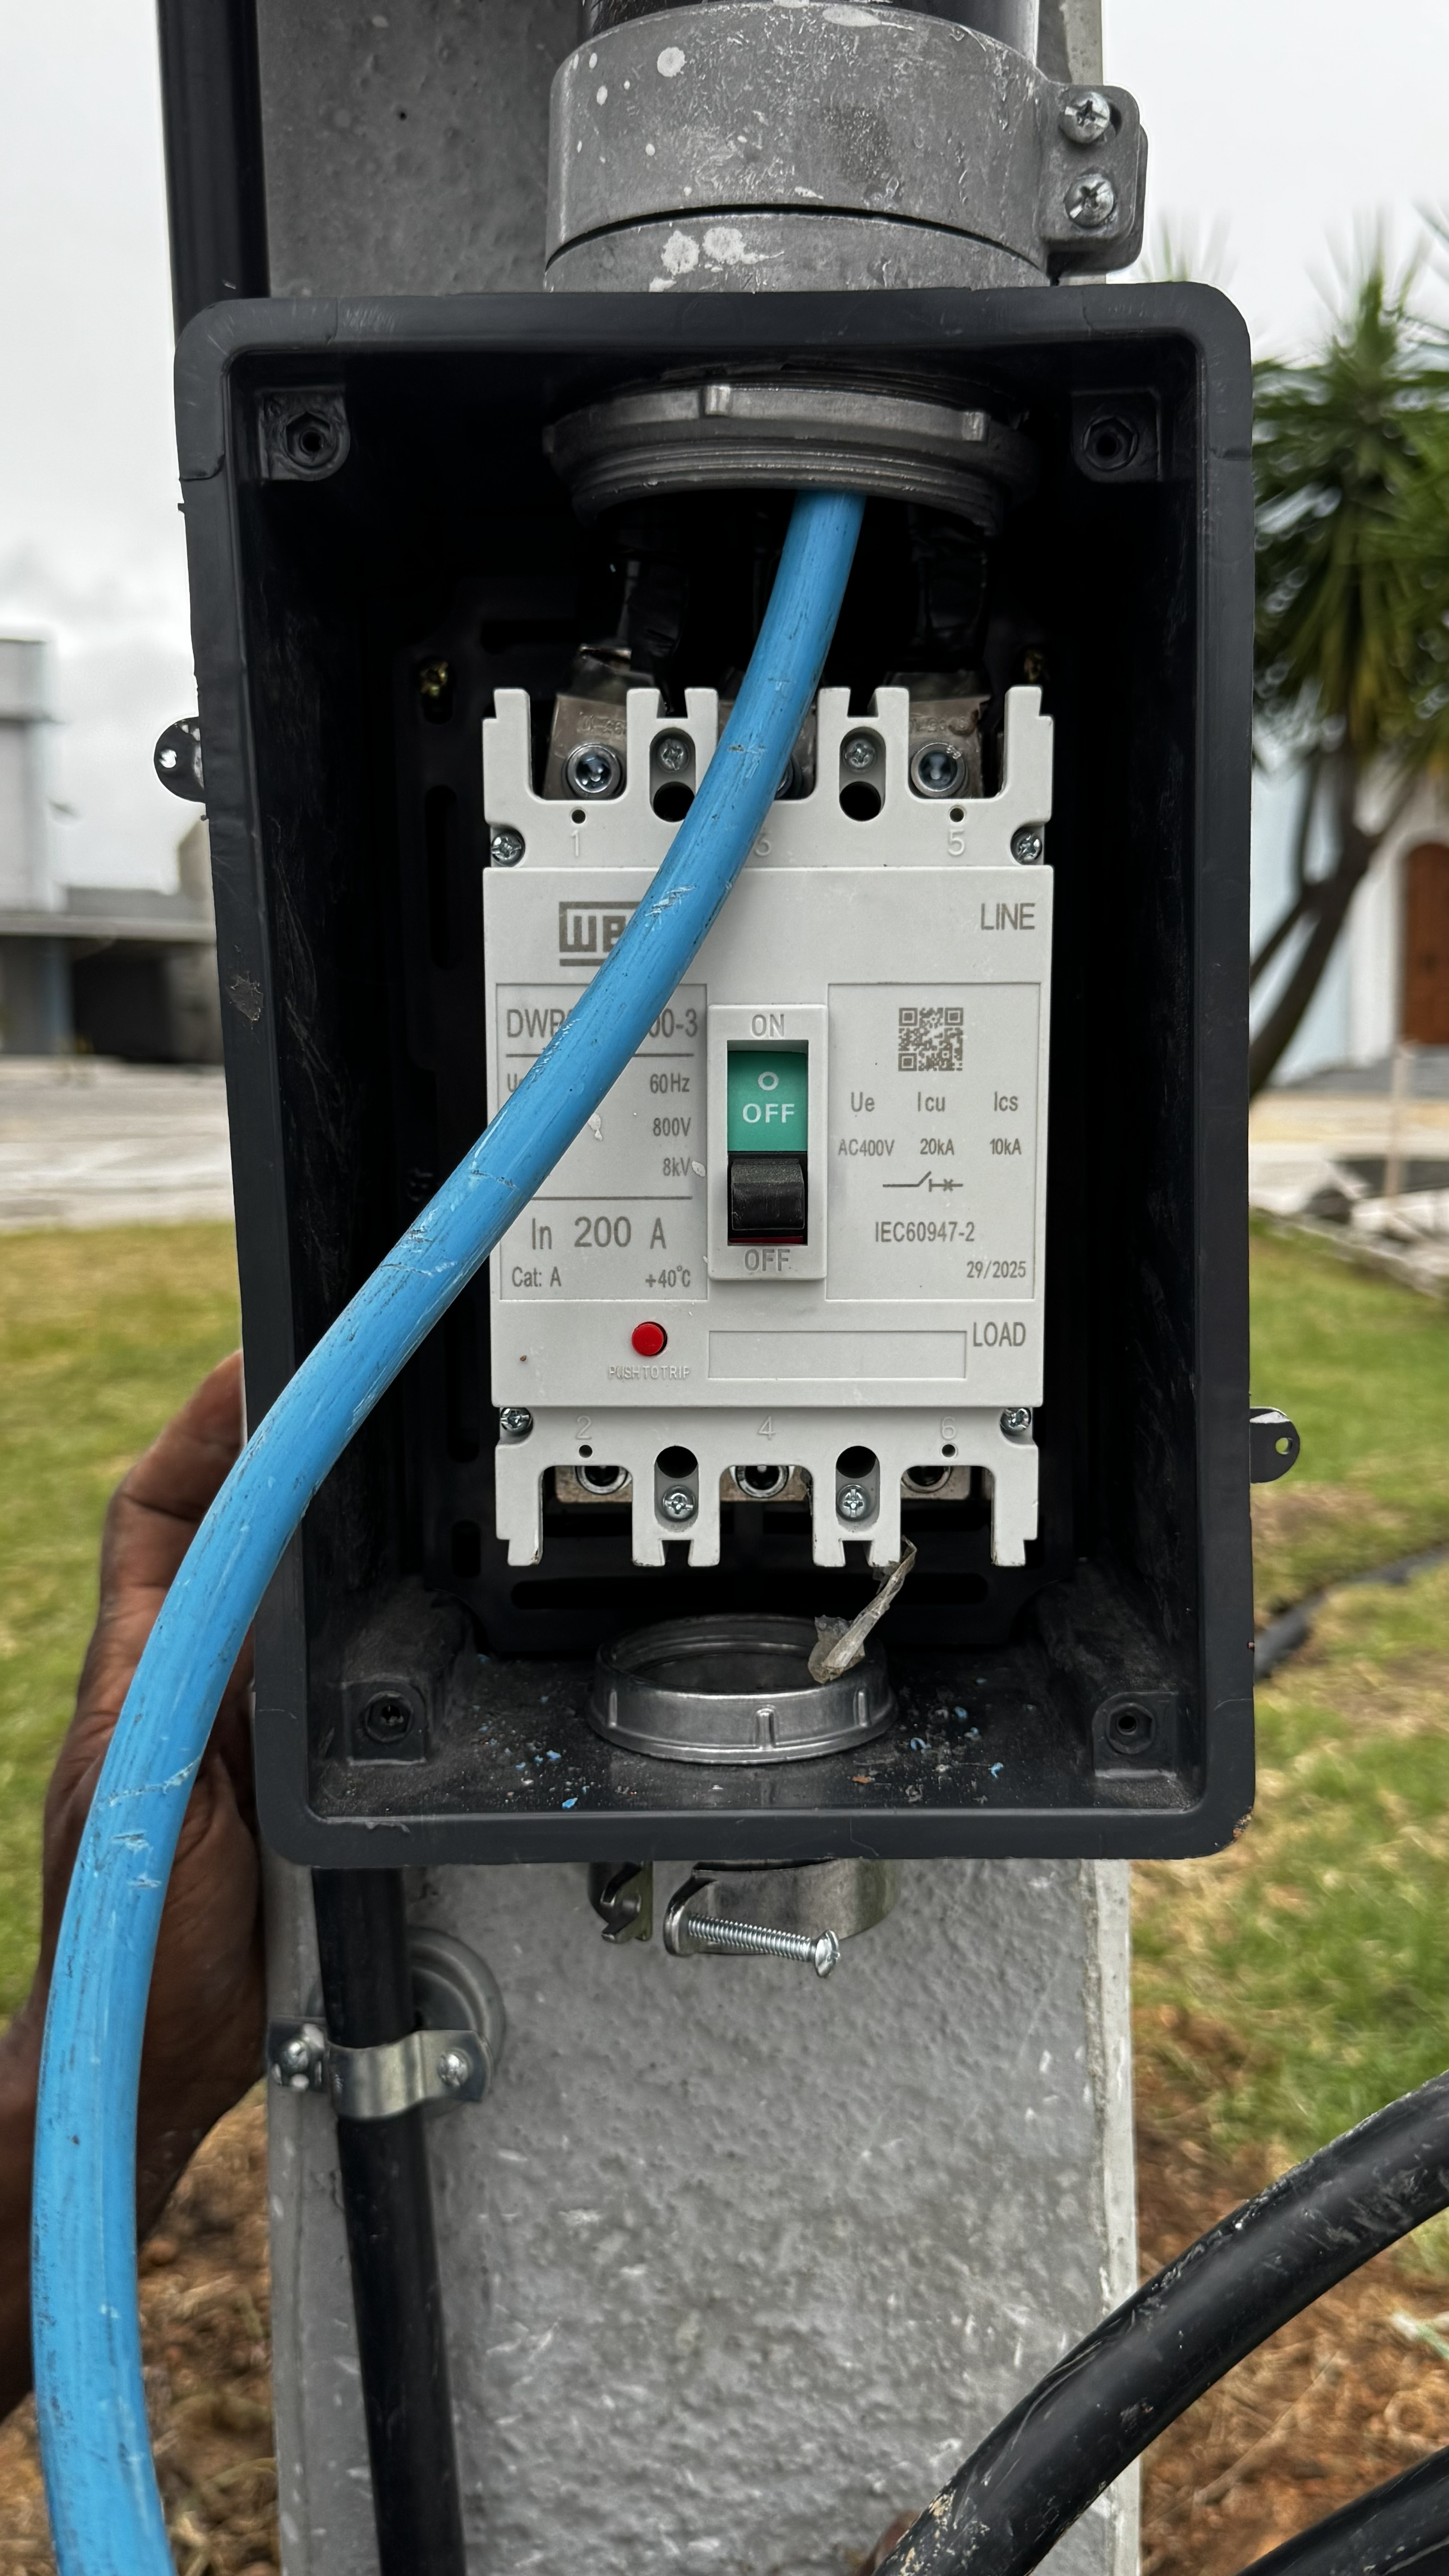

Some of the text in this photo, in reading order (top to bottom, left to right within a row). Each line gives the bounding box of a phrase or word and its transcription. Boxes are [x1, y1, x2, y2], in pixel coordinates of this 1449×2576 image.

[570, 830, 580, 856] 1
[948, 829, 965, 856] 5
[980, 902, 1035, 930] LINE
[751, 1014, 785, 1038] ON
[650, 1072, 690, 1094] 60Hz
[743, 1103, 795, 1123] OFF
[851, 1091, 1019, 1113] Ue Icu Ics
[653, 1117, 691, 1137] 800V
[837, 1137, 1022, 1157] AC400V 20kA 10kA
[662, 1156, 691, 1177] 8kV
[531, 1215, 667, 1251] In 200 A
[875, 1221, 975, 1243] IEC60947-2
[744, 1248, 791, 1272] OFF
[966, 1260, 1026, 1279] 29/2025
[511, 1265, 543, 1288] Cat:
[549, 1266, 562, 1288] A
[972, 1321, 1026, 1348] LOAD
[575, 1416, 592, 1440] 2
[757, 1416, 776, 1441] 4
[940, 1416, 957, 1441] 6
